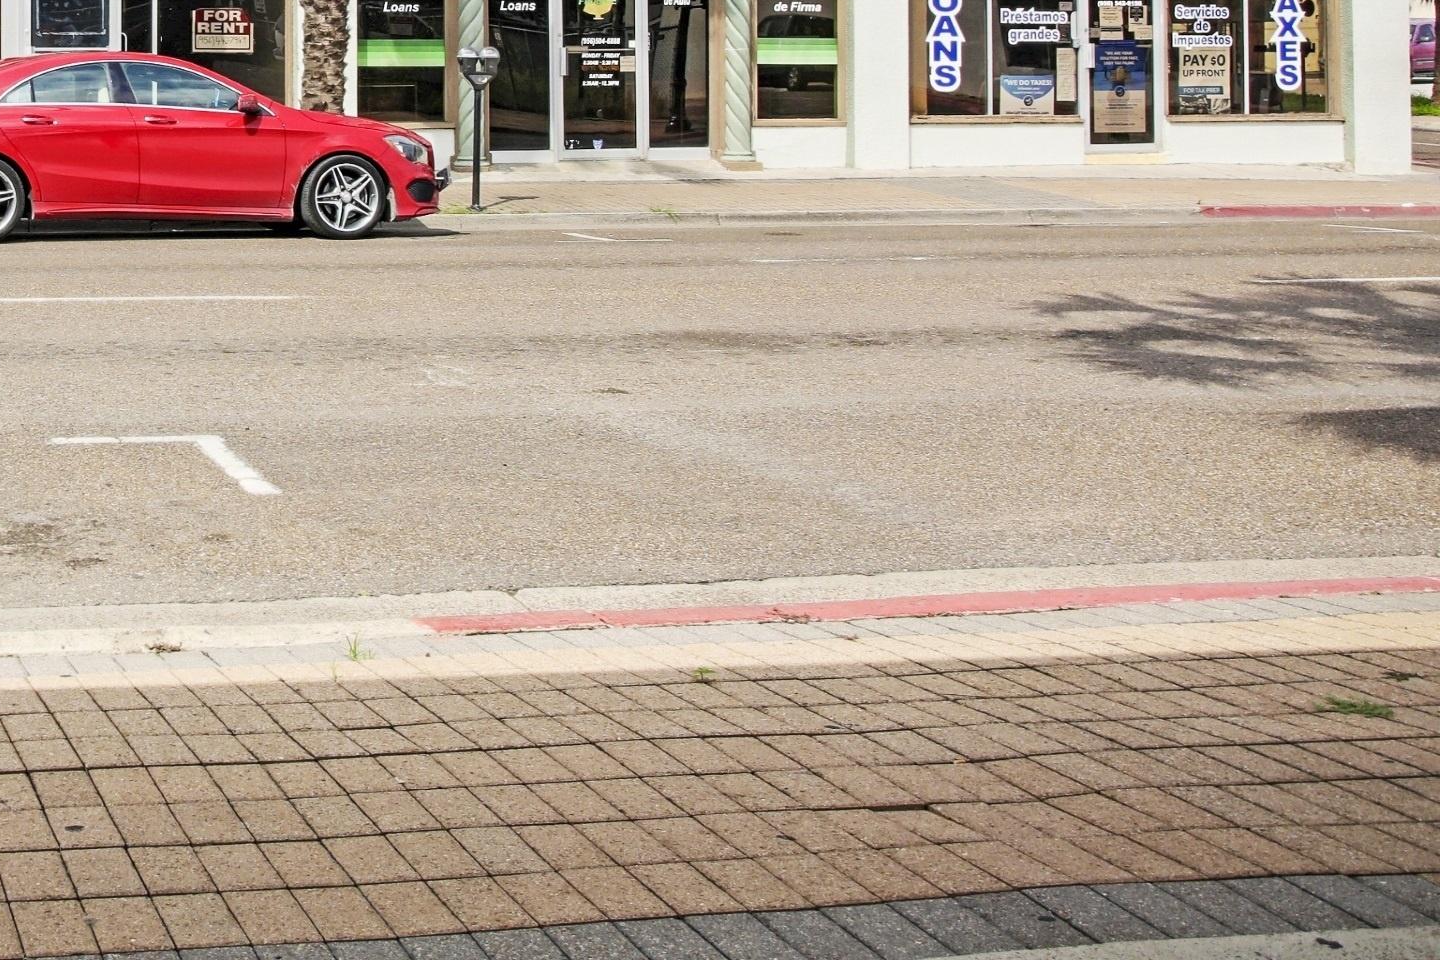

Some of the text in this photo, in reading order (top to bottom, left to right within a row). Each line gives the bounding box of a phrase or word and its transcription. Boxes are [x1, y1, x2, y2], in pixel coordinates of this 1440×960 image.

[383, 1, 419, 12] Loans
[500, 1, 536, 11] Loans
[773, 2, 822, 12] de Firma
[1175, 5, 1228, 18] Servicios
[203, 10, 241, 21] FOR
[197, 22, 248, 33] RENT
[1194, 20, 1210, 32] de
[1009, 27, 1060, 44] grandes
[1173, 32, 1232, 47] impuestos
[1183, 54, 1226, 66] PAY $0
